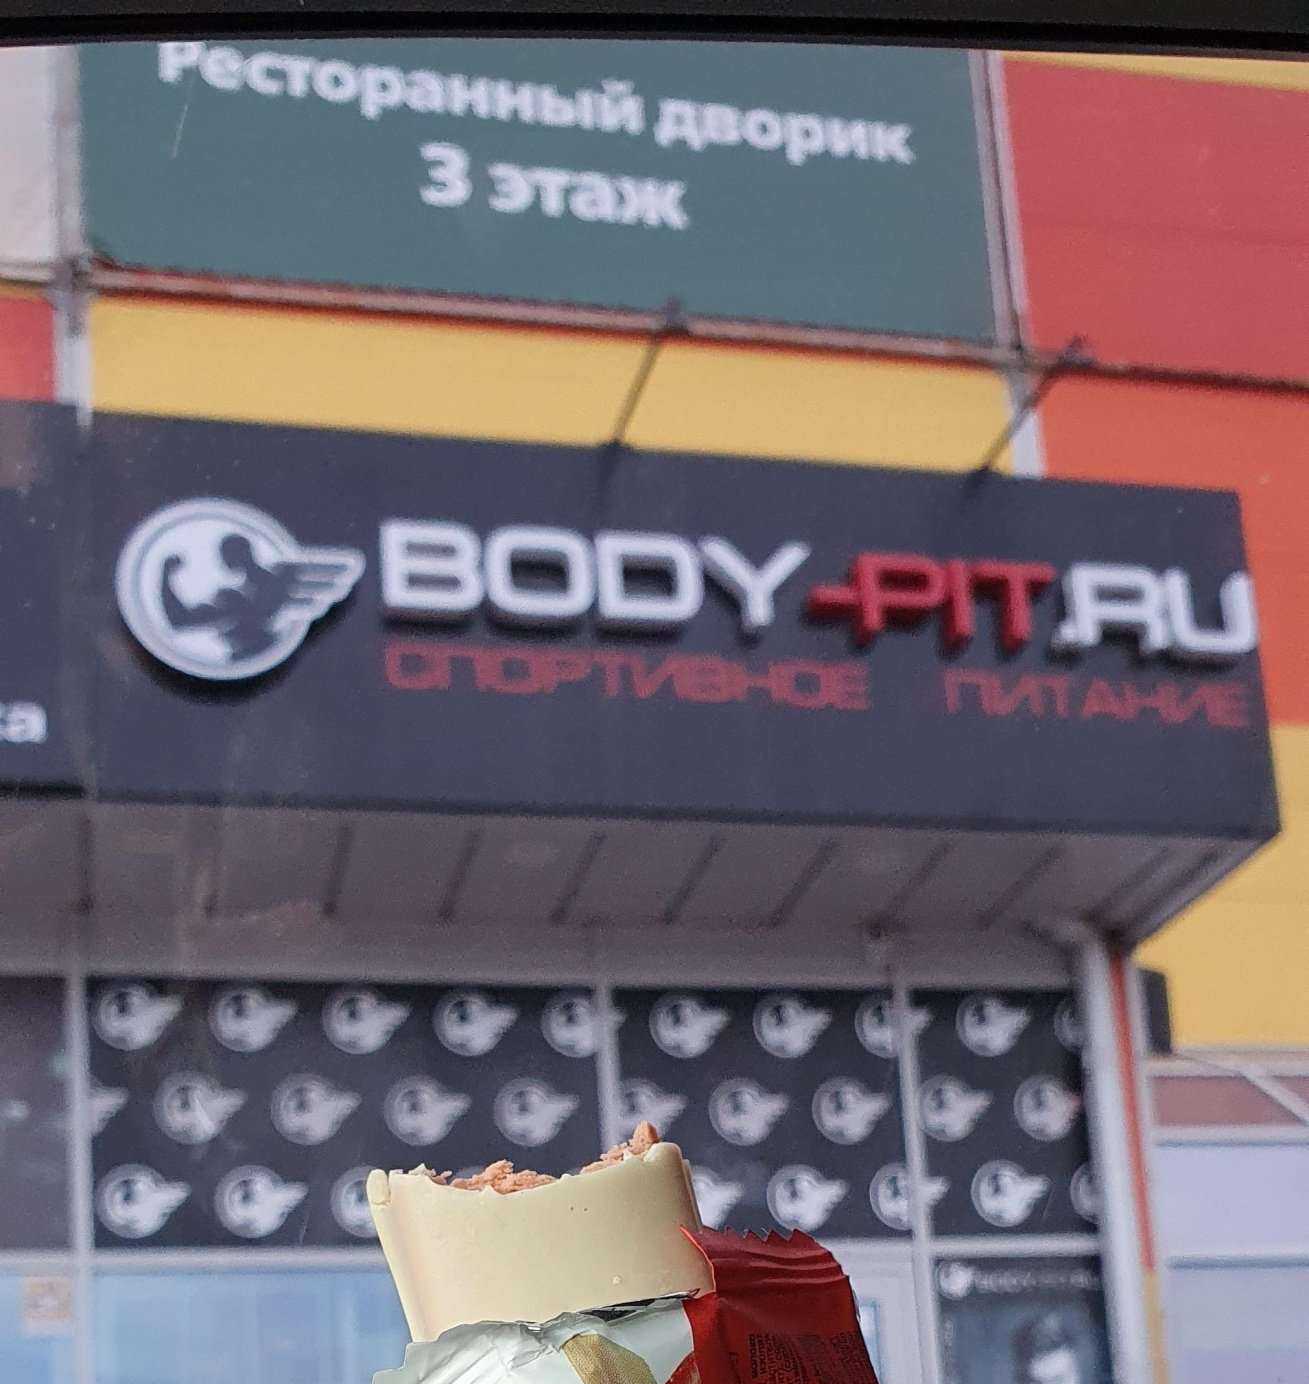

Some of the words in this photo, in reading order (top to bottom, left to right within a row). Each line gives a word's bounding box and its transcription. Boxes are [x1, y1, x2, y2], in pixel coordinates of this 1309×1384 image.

[158, 41, 646, 136] Ресторанный
[653, 99, 917, 166] дворик
[419, 142, 474, 208] 3
[487, 162, 690, 231] этаж
[383, 640, 869, 711] СПОРТИВНОЕ
[942, 667, 1255, 729] ПИТАНИЕ
